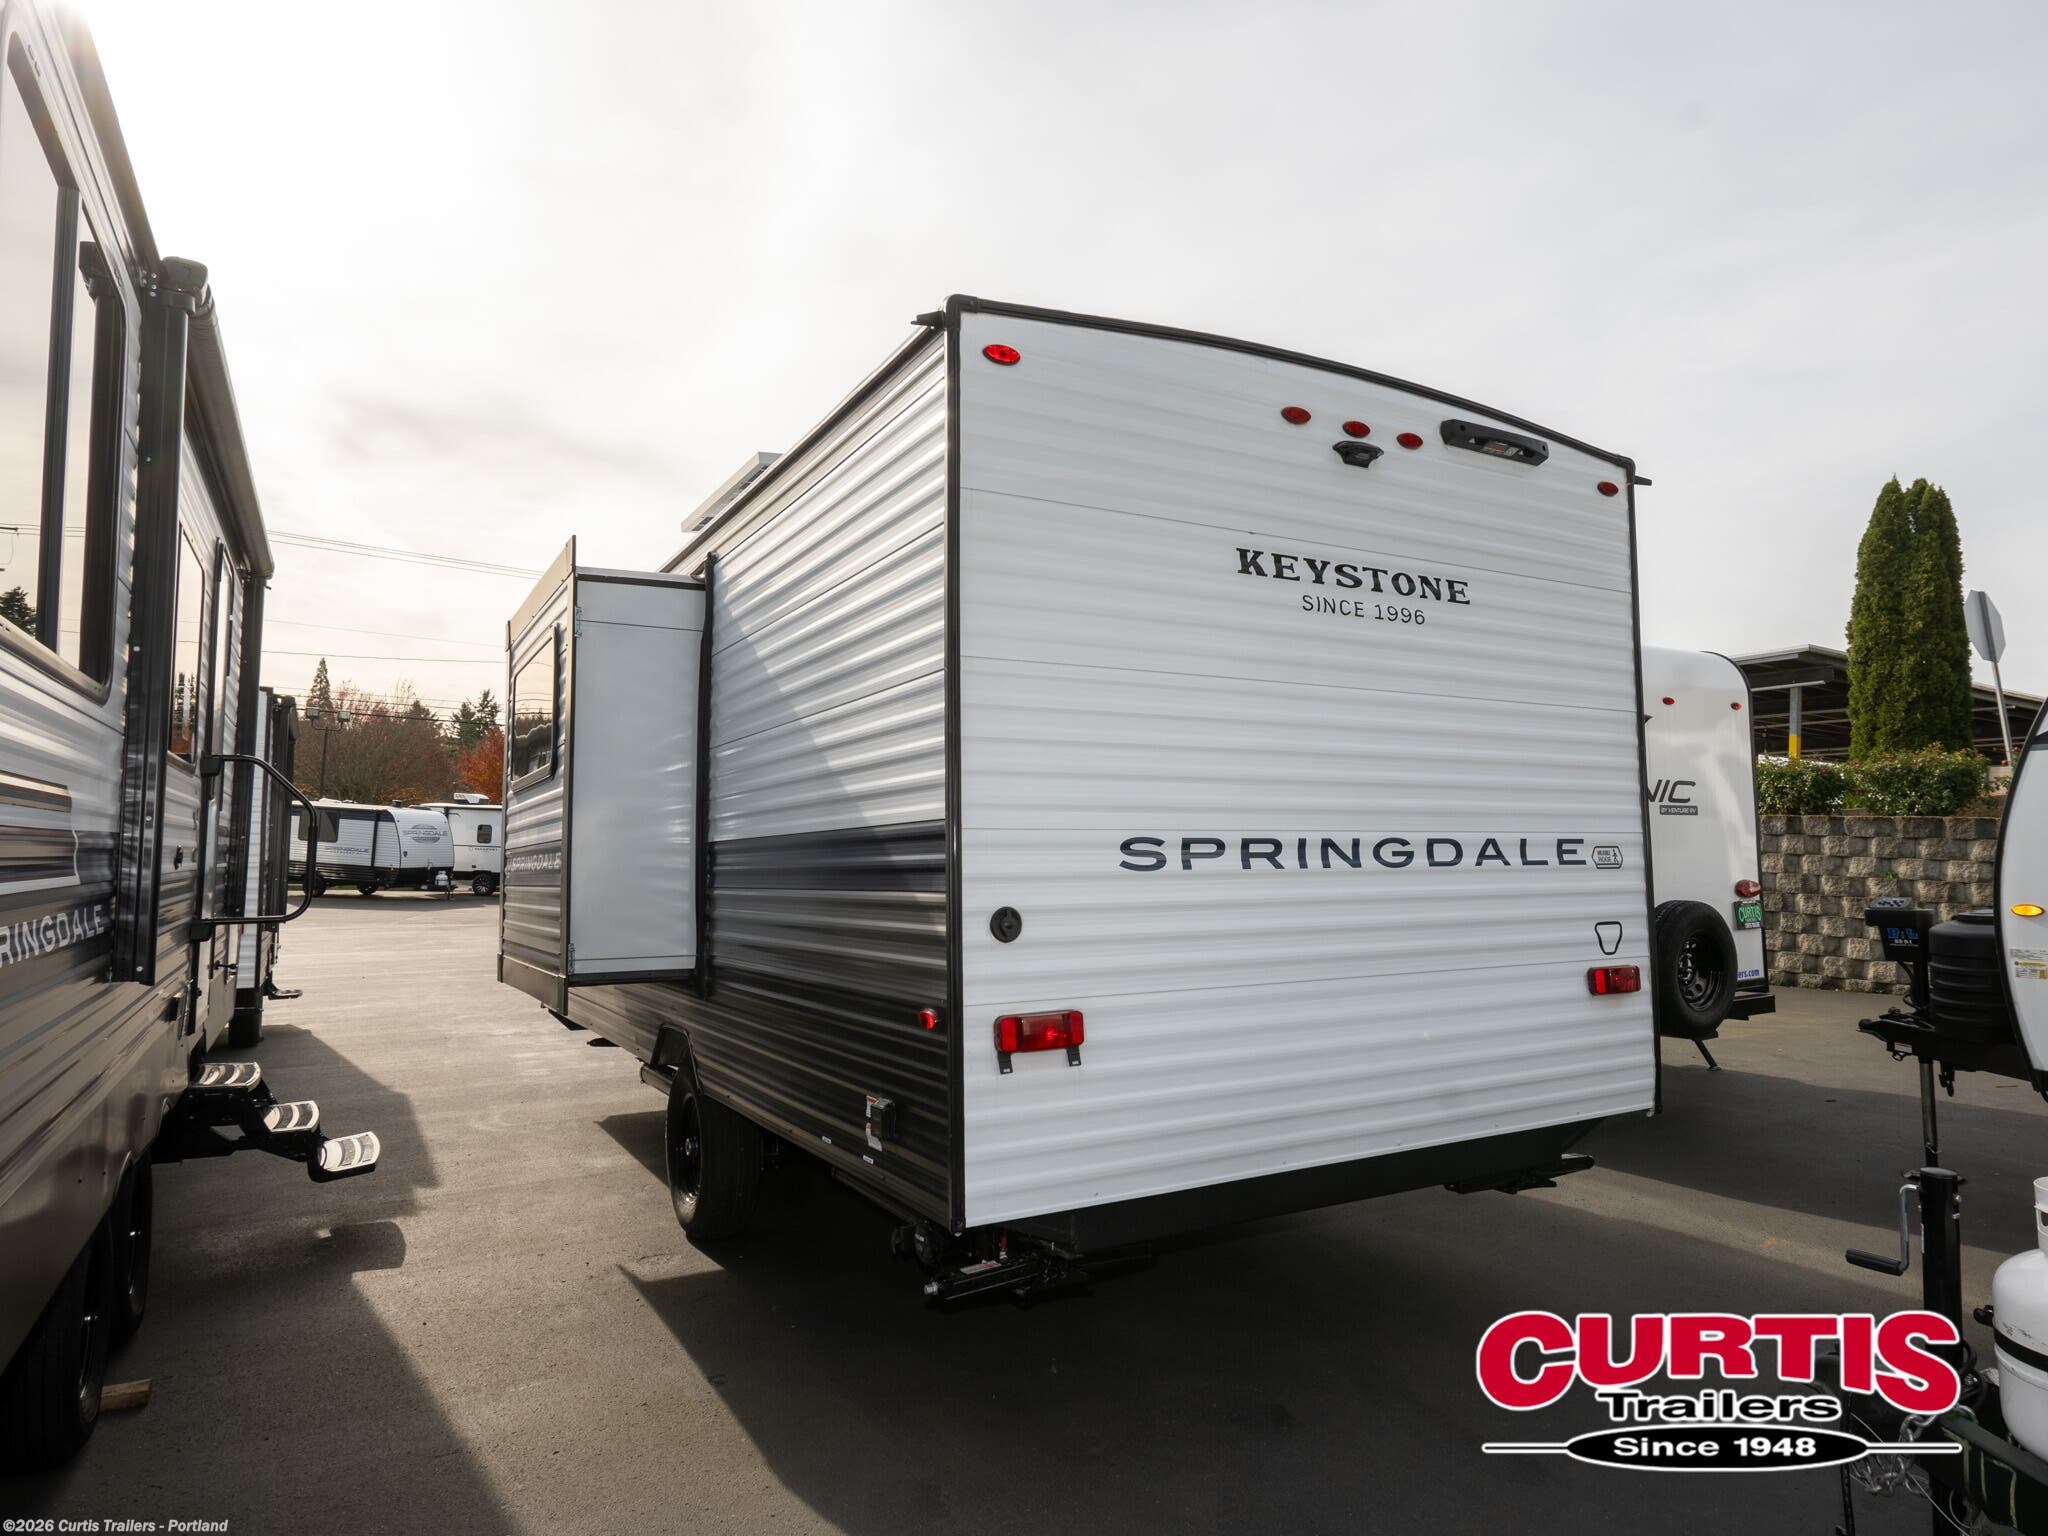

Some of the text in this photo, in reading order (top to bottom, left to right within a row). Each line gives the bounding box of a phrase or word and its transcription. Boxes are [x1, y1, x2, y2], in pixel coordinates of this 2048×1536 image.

[1236, 548, 1471, 605] KEYSTONE
[1302, 594, 1426, 625] SINCE 1996
[511, 852, 562, 872] SPRINGDALE
[1119, 836, 1588, 872] SPRINGDALE
[1738, 904, 1762, 923] CURTIS
